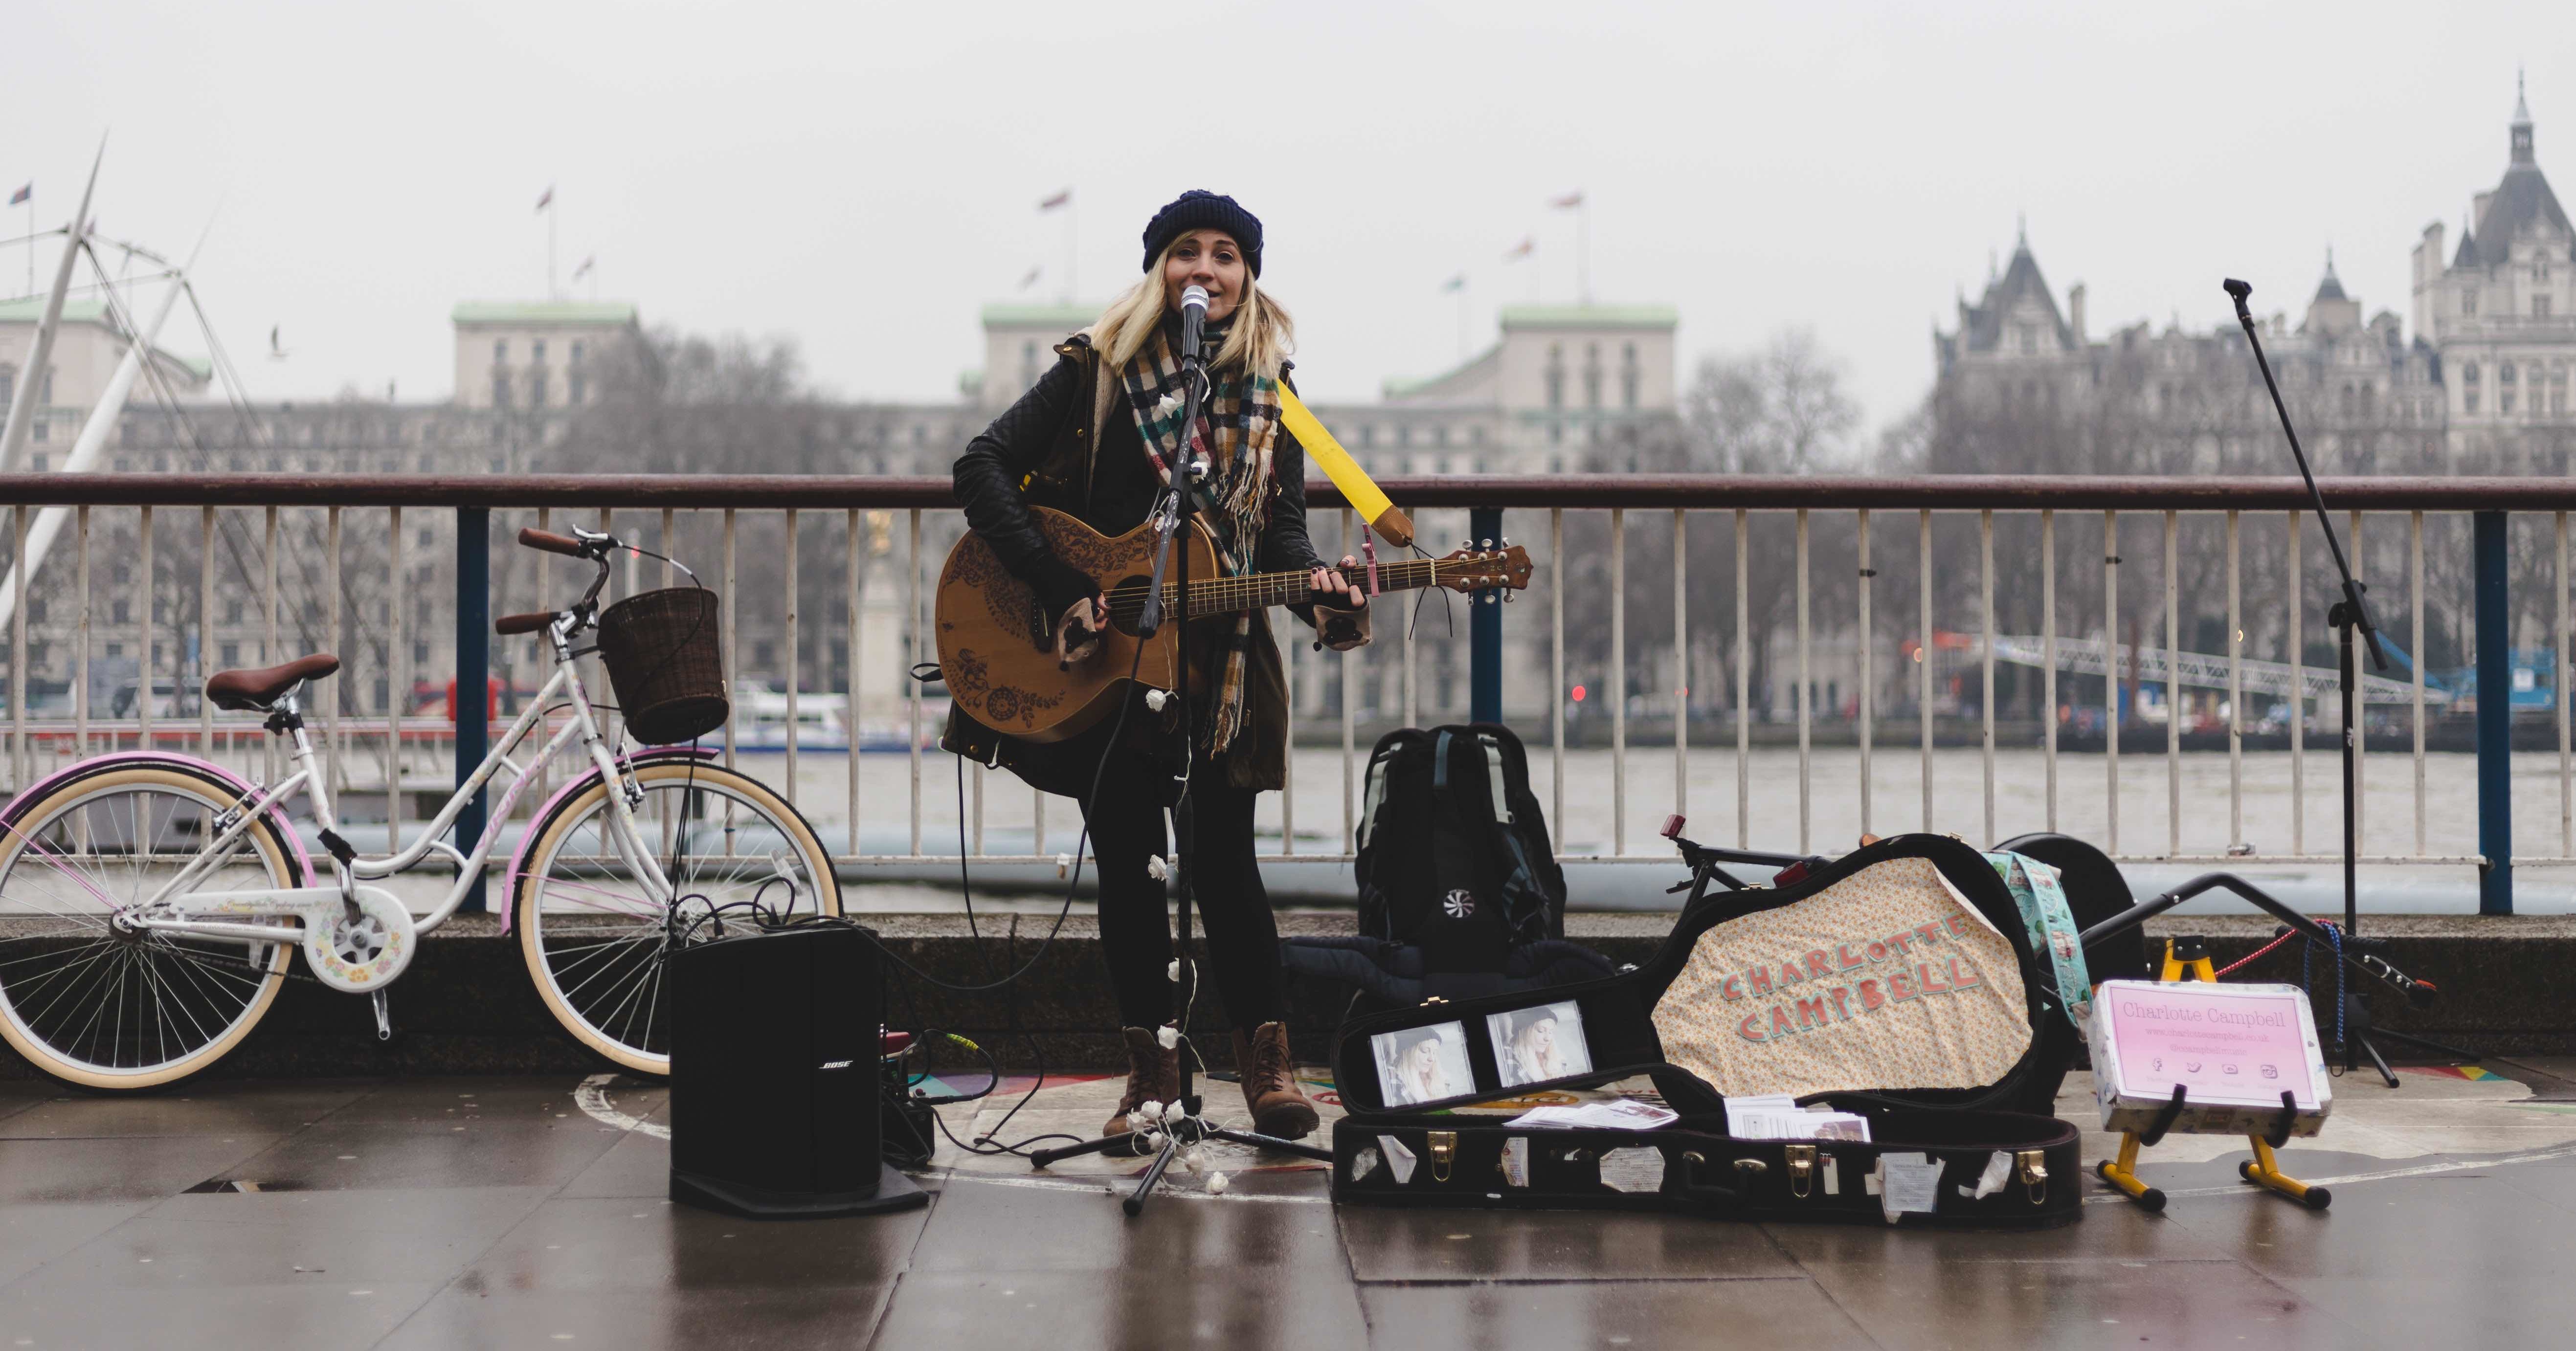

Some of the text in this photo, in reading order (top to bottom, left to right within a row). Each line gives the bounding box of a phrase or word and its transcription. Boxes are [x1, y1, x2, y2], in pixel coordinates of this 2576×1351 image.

[1721, 913, 1968, 1001] CHARLOTTE
[1737, 955, 1980, 1042] CAMPBELL
[2123, 1001, 2286, 1028] Charlotte Campbell
[818, 1060, 853, 1069] BOSE
